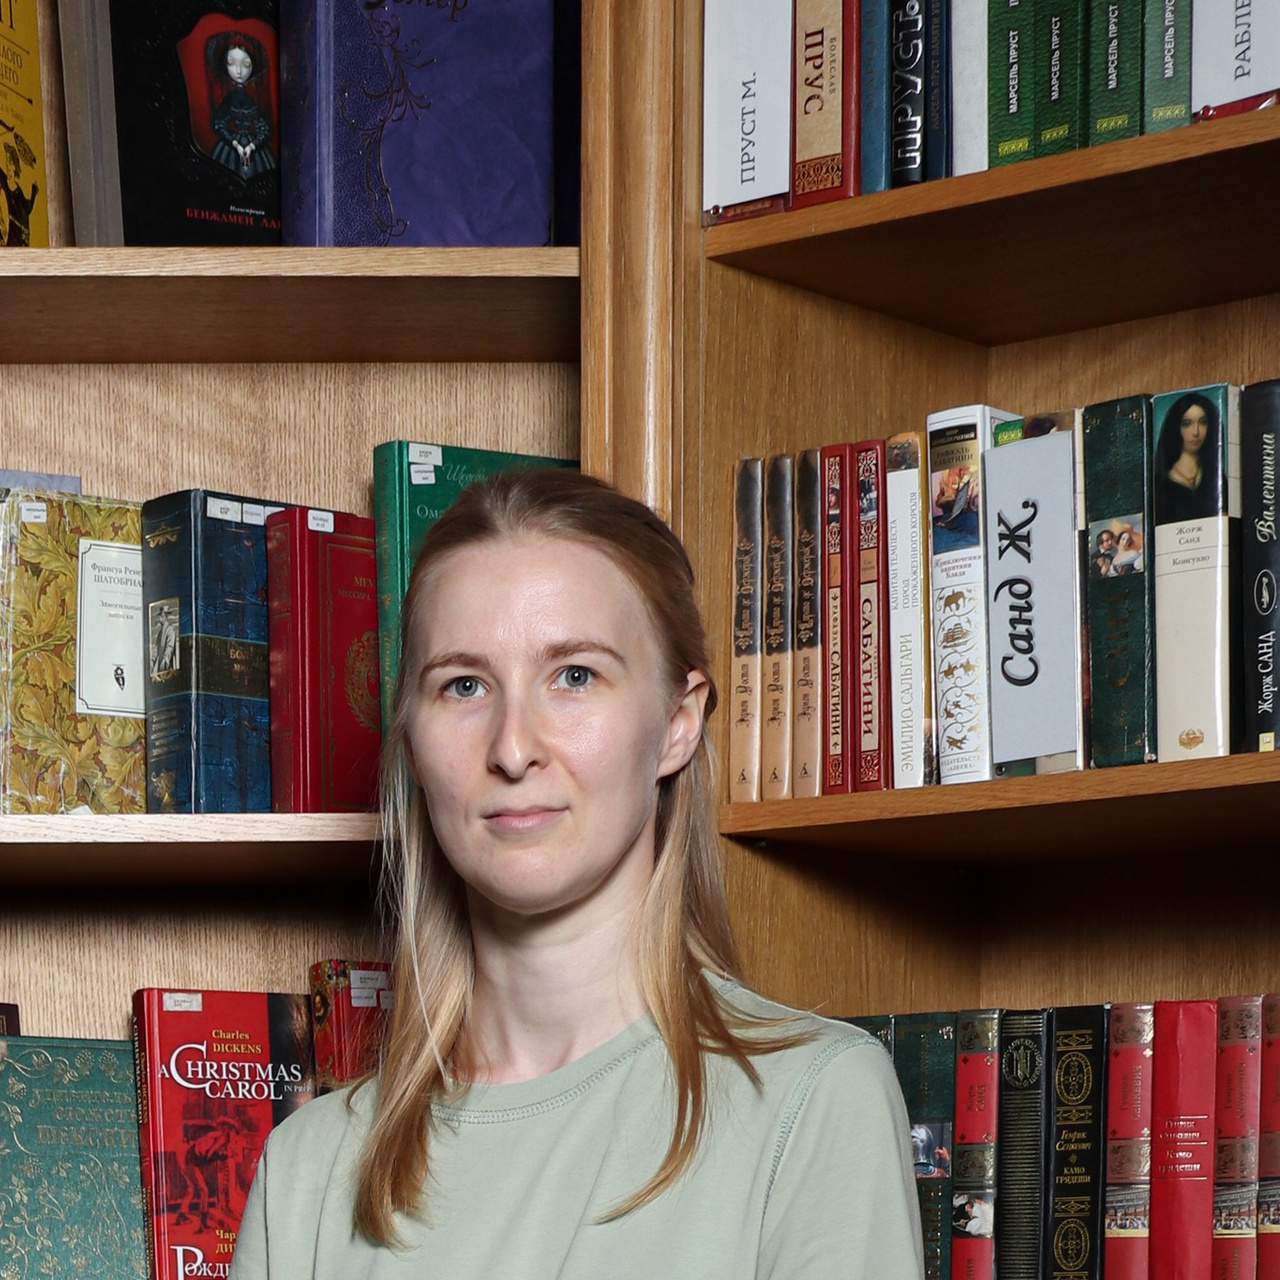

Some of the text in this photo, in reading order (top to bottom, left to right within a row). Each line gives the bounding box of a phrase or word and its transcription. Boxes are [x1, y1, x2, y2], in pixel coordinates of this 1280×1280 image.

[803, 26, 825, 116] ПРУС
[829, 36, 837, 96] БОЛЕСЛАВ
[1008, 30, 1019, 114] МАРСЕЛЬ ПРУСТ
[1050, 16, 1061, 101] МАРСЕЛЬ ПРУСТ
[1108, 3, 1119, 90] МАРСЕЛЬ ПРУСТ
[740, 72, 757, 186] ПРУСТ М.
[1256, 433, 1278, 543] Валентина
[889, 518, 900, 611] КАПИТАН ТЕМПЕСТА
[909, 491, 919, 608] ПРОКАЖЕННОГО КОРОЛЯ
[1171, 554, 1211, 567] Консуэло
[902, 578, 911, 609] ГОРОД
[993, 577, 1040, 688] Санд
[830, 605, 841, 737] РАФАЭЛЬ САБАТИНИ
[860, 598, 874, 736] САБАТИНИ
[898, 633, 914, 772] ЭМИЛИО САЛЬГАРИ
[1258, 630, 1277, 715] Жорж САНД
[157, 1040, 303, 1090] A CHRISTMAS
[211, 1029, 250, 1040] Charles
[212, 1043, 262, 1054] DICKENS
[205, 1081, 283, 1101] CAROL
[1055, 1137, 1093, 1153] Сенкевич
[1060, 1129, 1089, 1143] Генрик
[1062, 1165, 1087, 1176] КАМО
